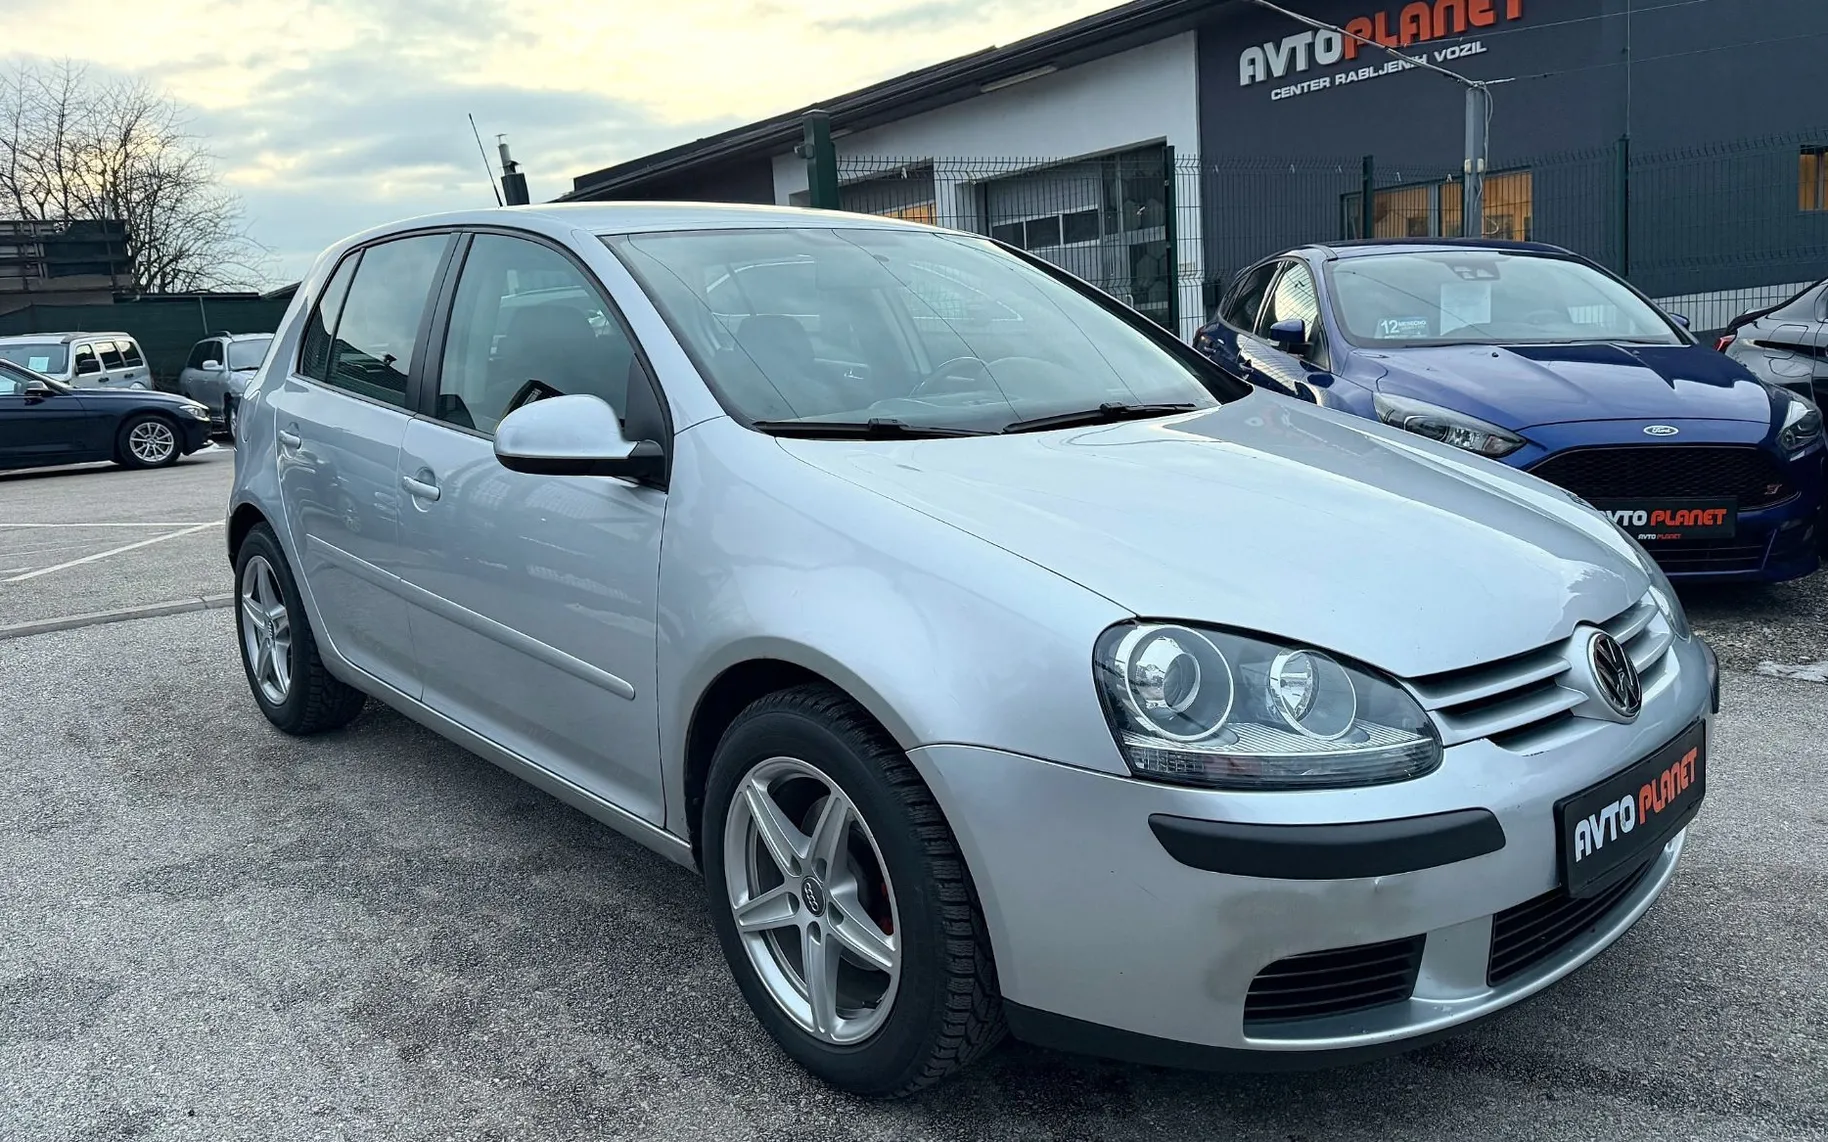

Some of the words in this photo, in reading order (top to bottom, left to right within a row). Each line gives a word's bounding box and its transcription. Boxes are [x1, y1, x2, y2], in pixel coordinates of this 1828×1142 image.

[1271, 77, 1331, 100] CENTER
[1335, 54, 1428, 86] RABLJENIH
[1433, 41, 1487, 62] VOZIL
[1380, 319, 1400, 334] 12
[1650, 508, 1727, 526] PLANET
[1574, 794, 1635, 863] AVTO
[1639, 746, 1698, 825] PLANET
